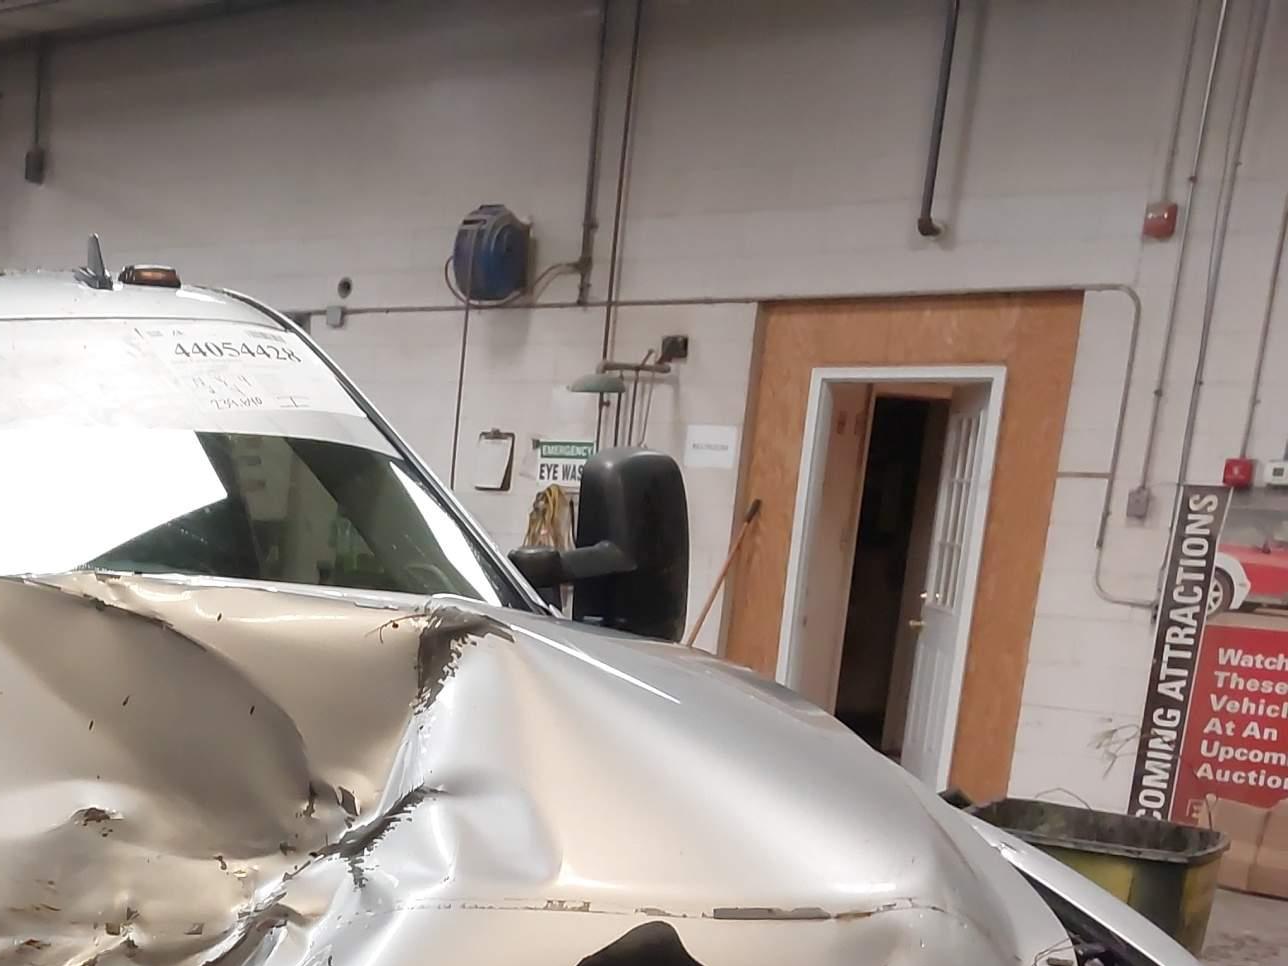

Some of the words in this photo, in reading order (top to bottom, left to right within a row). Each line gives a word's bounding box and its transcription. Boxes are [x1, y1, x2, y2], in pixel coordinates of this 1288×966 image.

[539, 463, 559, 481] EYE
[1157, 493, 1219, 701] ATTRACTIONS
[1218, 647, 1288, 671] Watch
[1214, 671, 1288, 695] These
[1203, 717, 1236, 737] At
[1241, 721, 1279, 741] An
